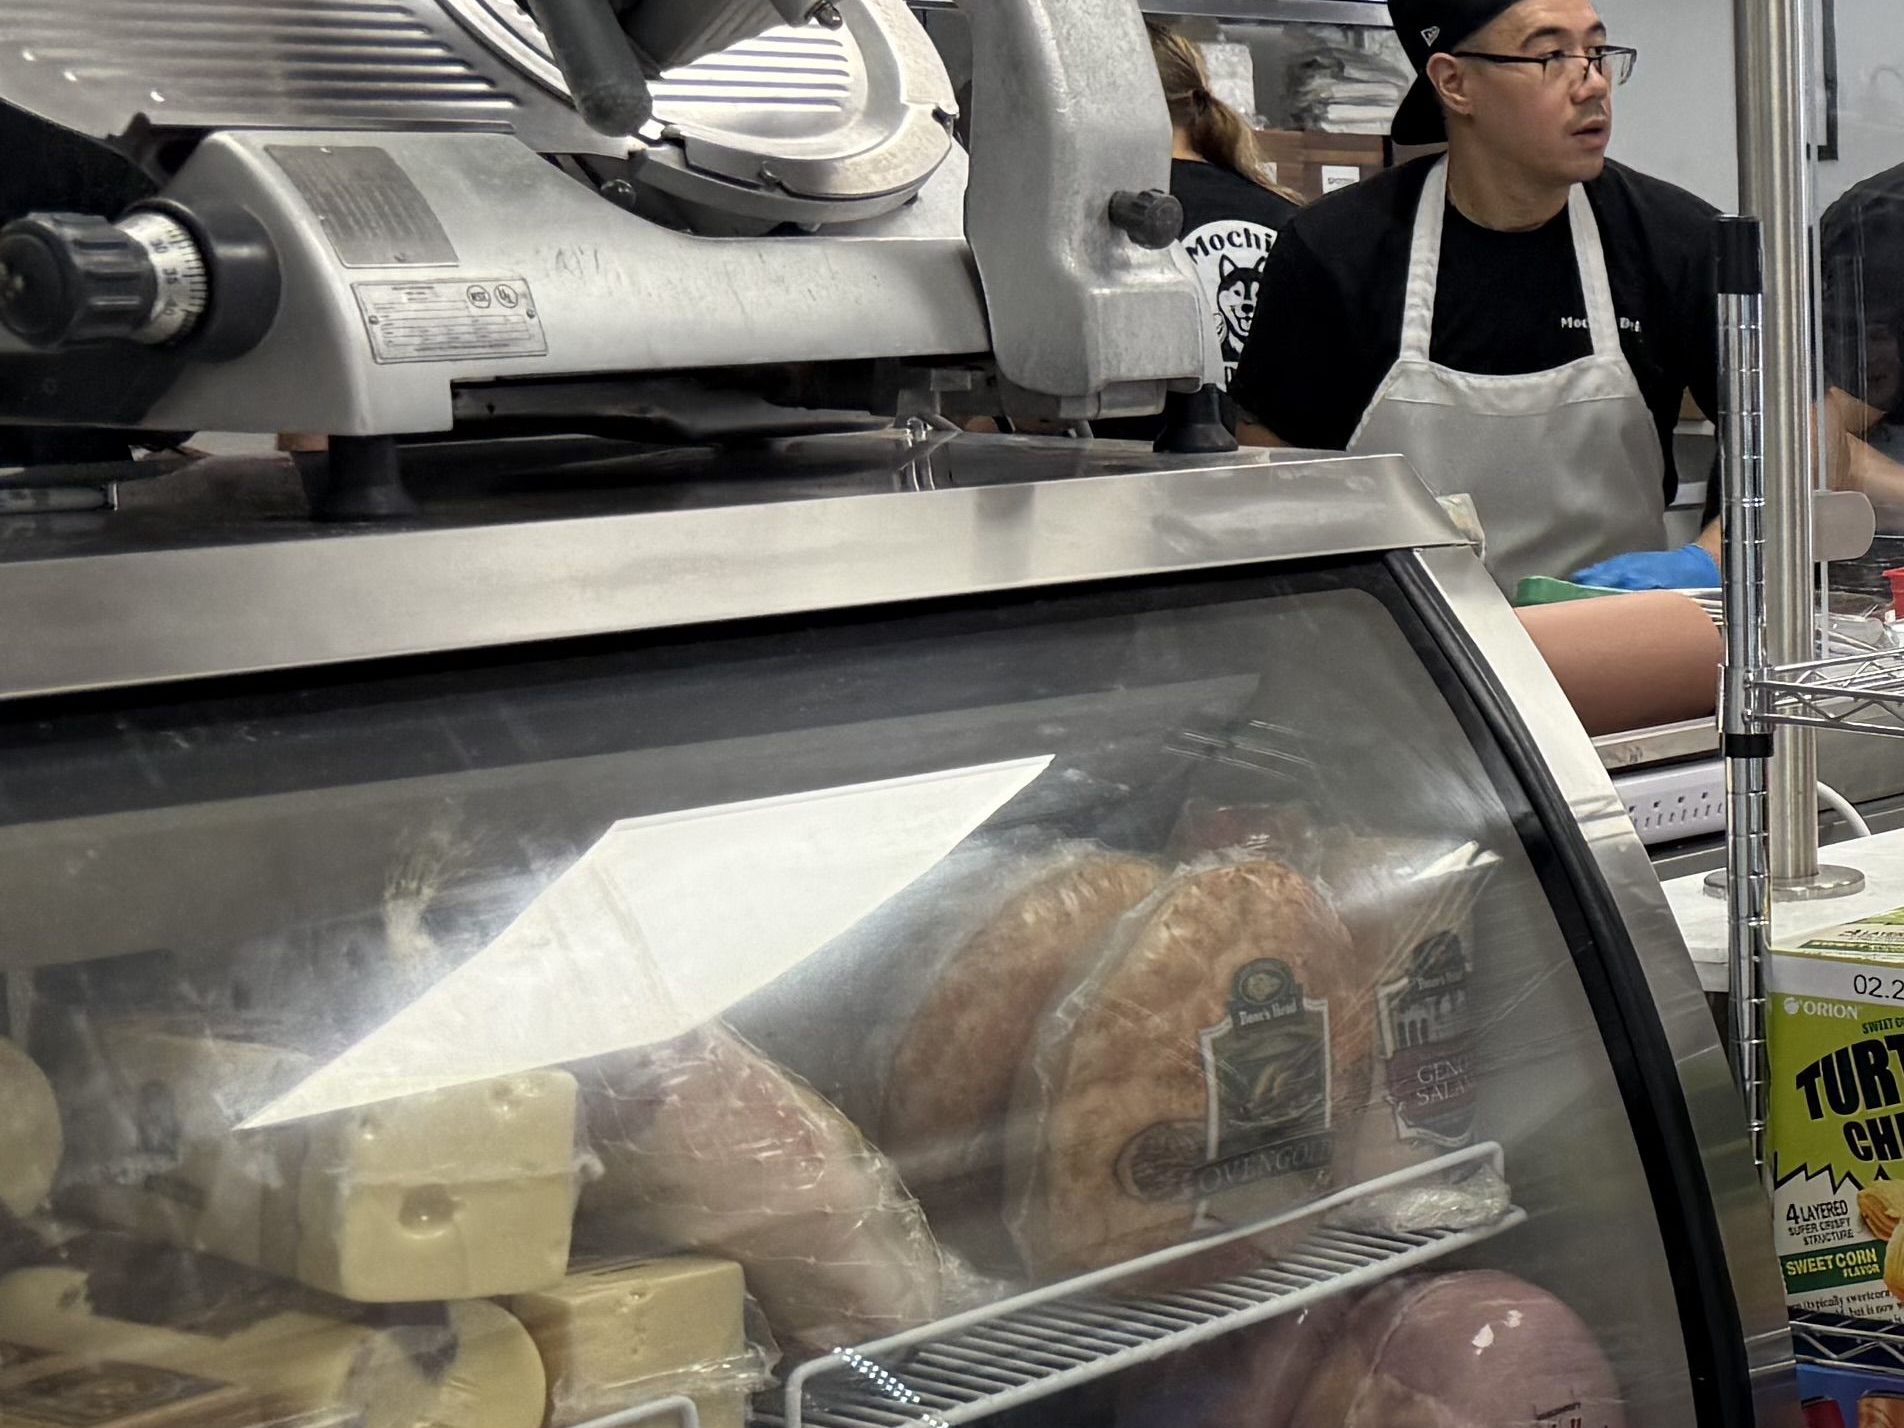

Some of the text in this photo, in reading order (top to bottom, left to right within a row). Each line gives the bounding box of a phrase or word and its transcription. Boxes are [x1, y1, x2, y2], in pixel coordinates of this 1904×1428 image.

[1801, 999, 1859, 1020] ORION
[1786, 1198, 1850, 1225] 4 LAYERED
[1788, 1217, 1852, 1237] SUPER CRISPY
[1802, 1228, 1854, 1247] STRUCTURE
[1786, 1247, 1879, 1277] SWEET CORN
[1843, 1262, 1882, 1280] FLAVOR
